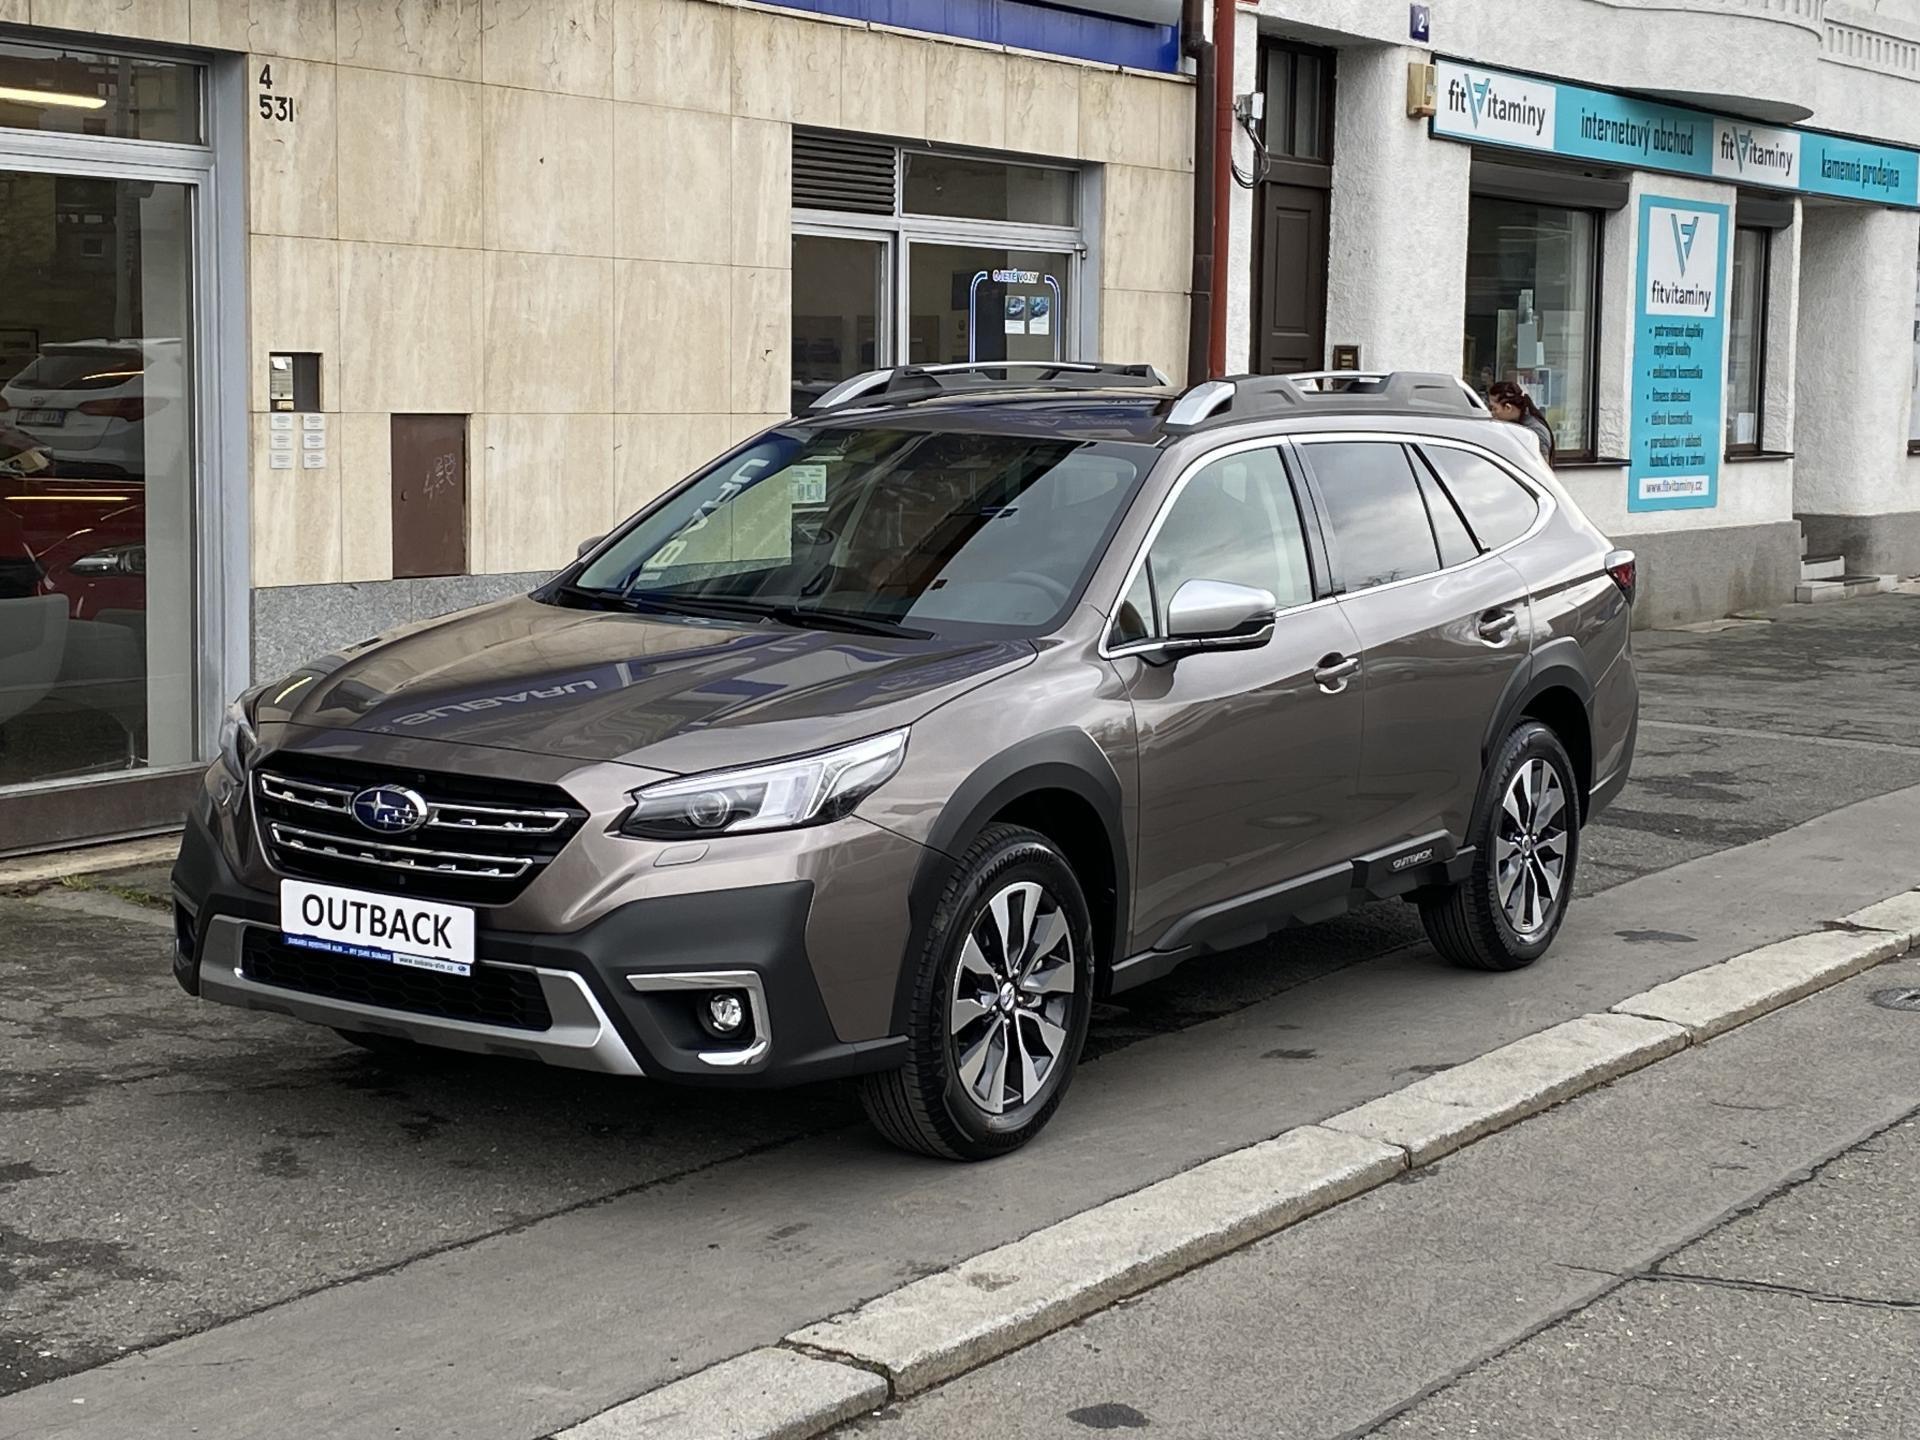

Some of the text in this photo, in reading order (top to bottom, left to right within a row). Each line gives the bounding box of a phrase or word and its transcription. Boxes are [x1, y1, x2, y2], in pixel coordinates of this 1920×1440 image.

[1418, 14, 1425, 32] 2
[259, 64, 272, 89] 4
[259, 94, 293, 122] 531
[1580, 108, 1695, 156] internetový obchod
[1821, 148, 1900, 193] kamenná prodejna
[1652, 279, 1711, 312] fitvitaminy
[302, 894, 452, 949] OUTBACK
